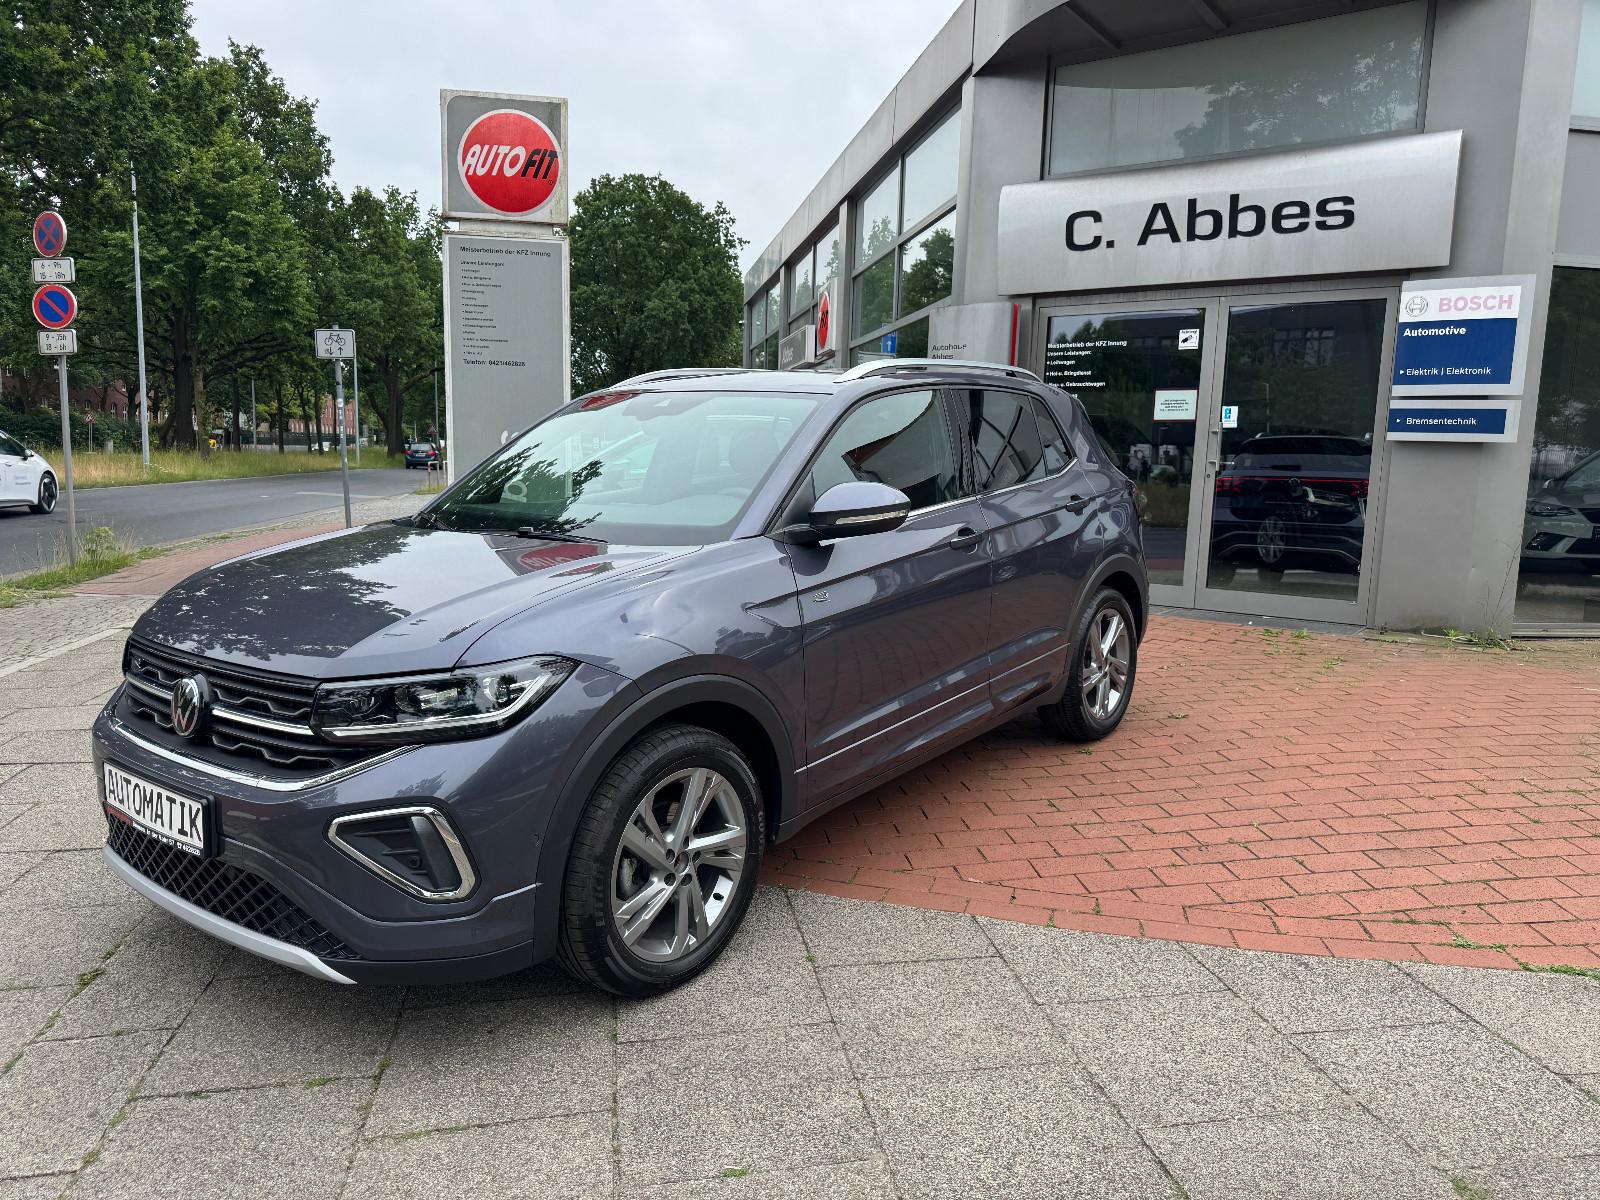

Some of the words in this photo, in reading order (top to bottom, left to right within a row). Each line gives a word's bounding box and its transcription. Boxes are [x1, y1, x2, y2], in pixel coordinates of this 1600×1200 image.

[463, 144, 558, 179] AUTOFIT
[1065, 209, 1115, 252] C.
[1157, 194, 1356, 246] Abbes
[1438, 294, 1514, 312] BOSCH
[1403, 325, 1467, 337] Automotive
[1406, 367, 1439, 376] Elektrik
[1446, 366, 1492, 376] Elektronik
[1406, 417, 1477, 426] Bremsentechnik
[108, 768, 202, 842] AUTOMATIK
